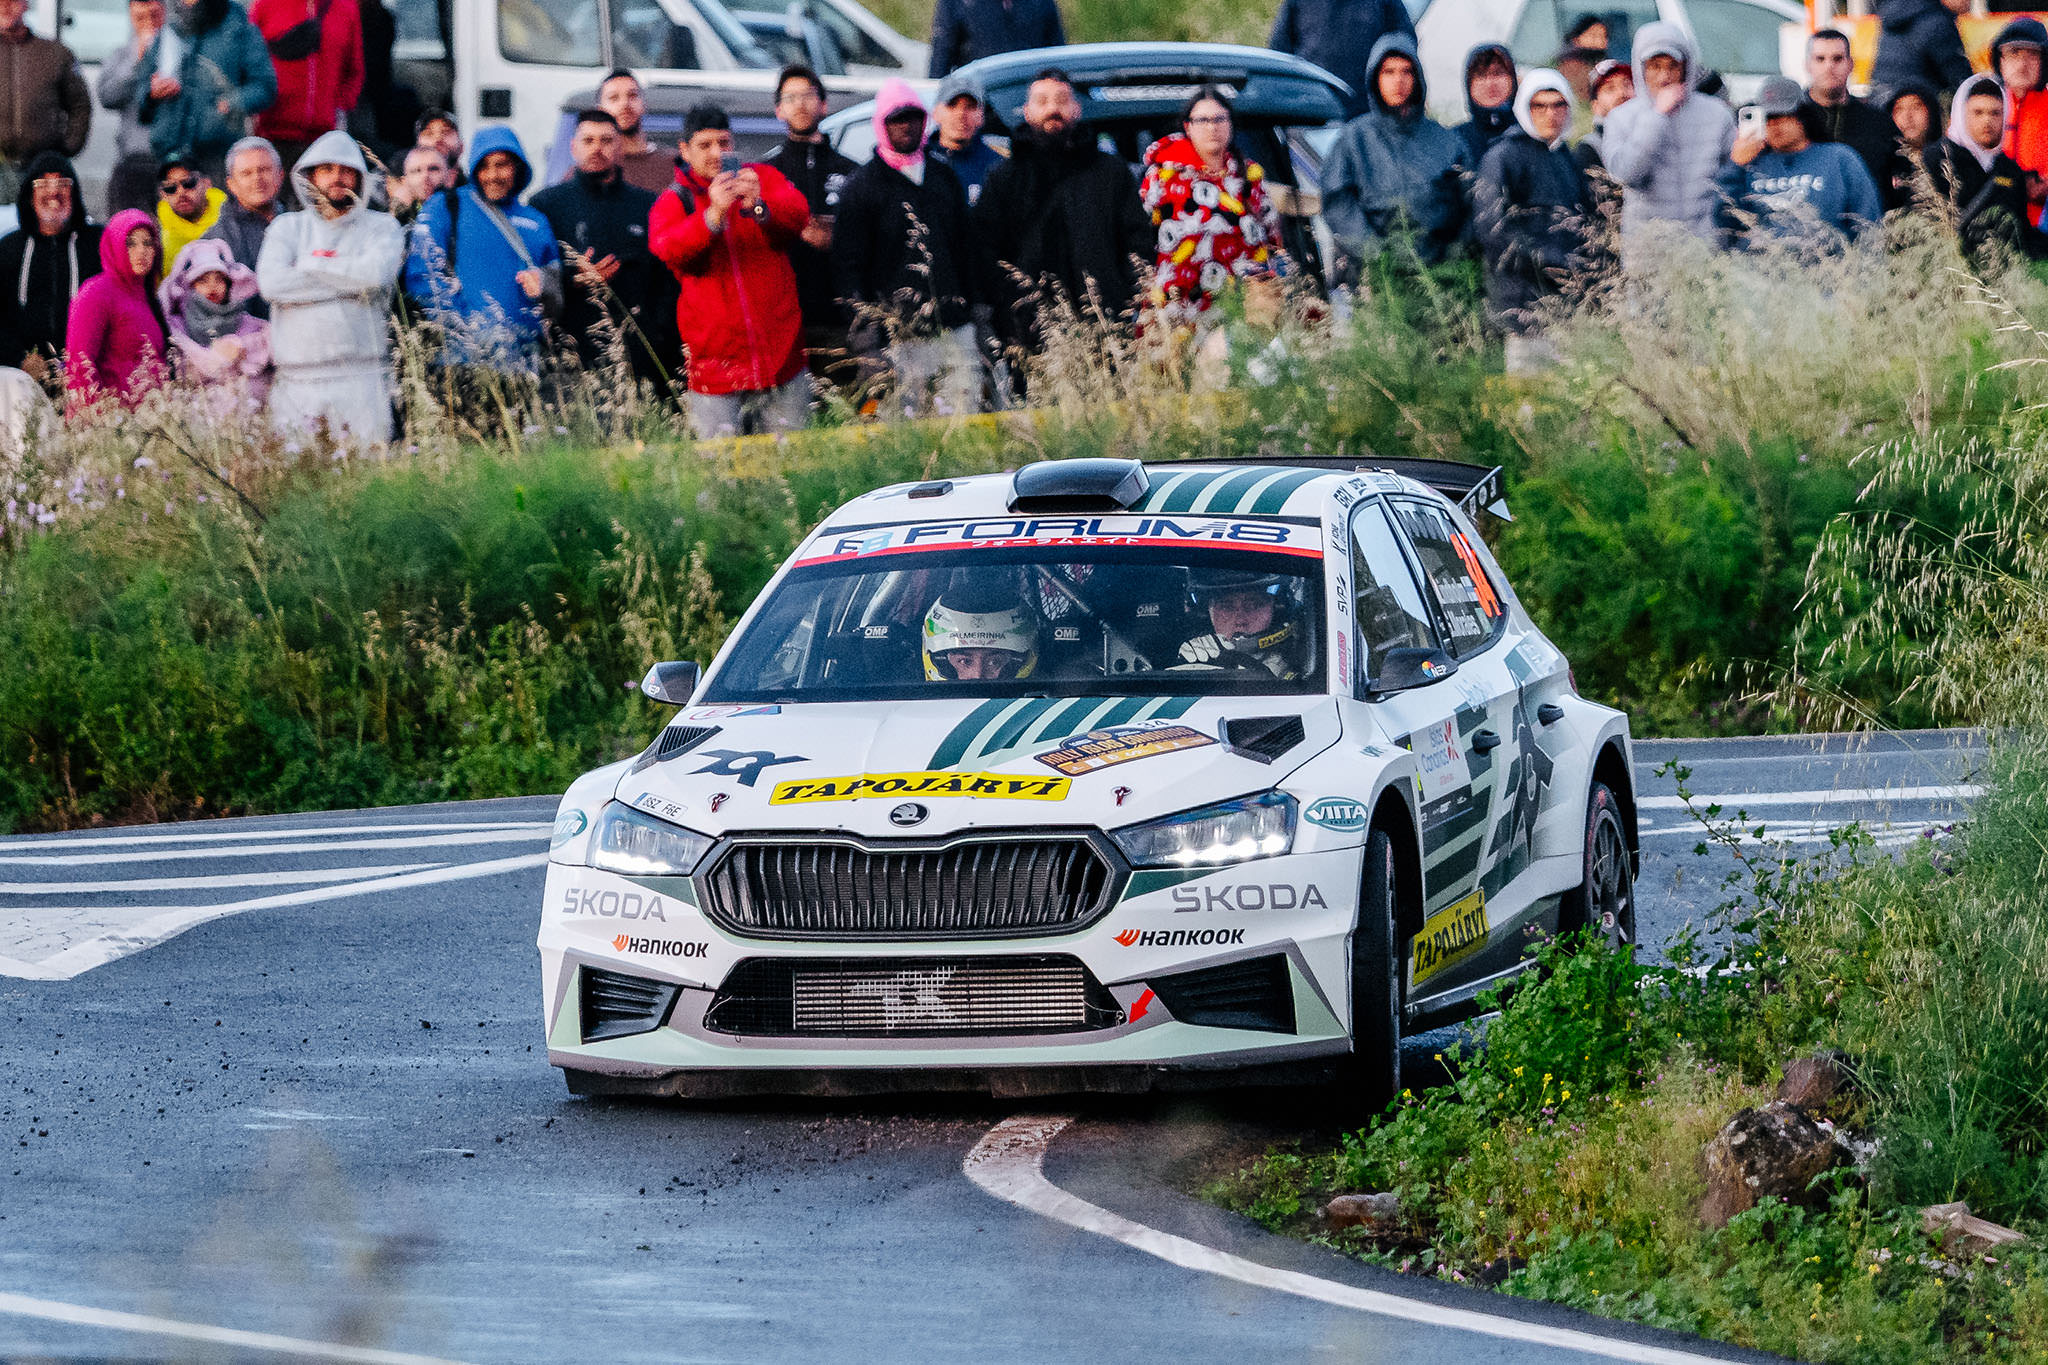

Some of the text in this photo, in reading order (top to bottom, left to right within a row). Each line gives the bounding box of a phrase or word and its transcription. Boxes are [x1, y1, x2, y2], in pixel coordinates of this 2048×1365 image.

[903, 519, 1291, 544] FORUM8
[864, 626, 889, 639] OMP
[1054, 628, 1080, 641] OMP
[1431, 664, 1447, 677] NEP
[1041, 749, 1083, 765] RALLY
[1118, 726, 1196, 745] CANARIAS
[1307, 805, 1367, 820] VIITA
